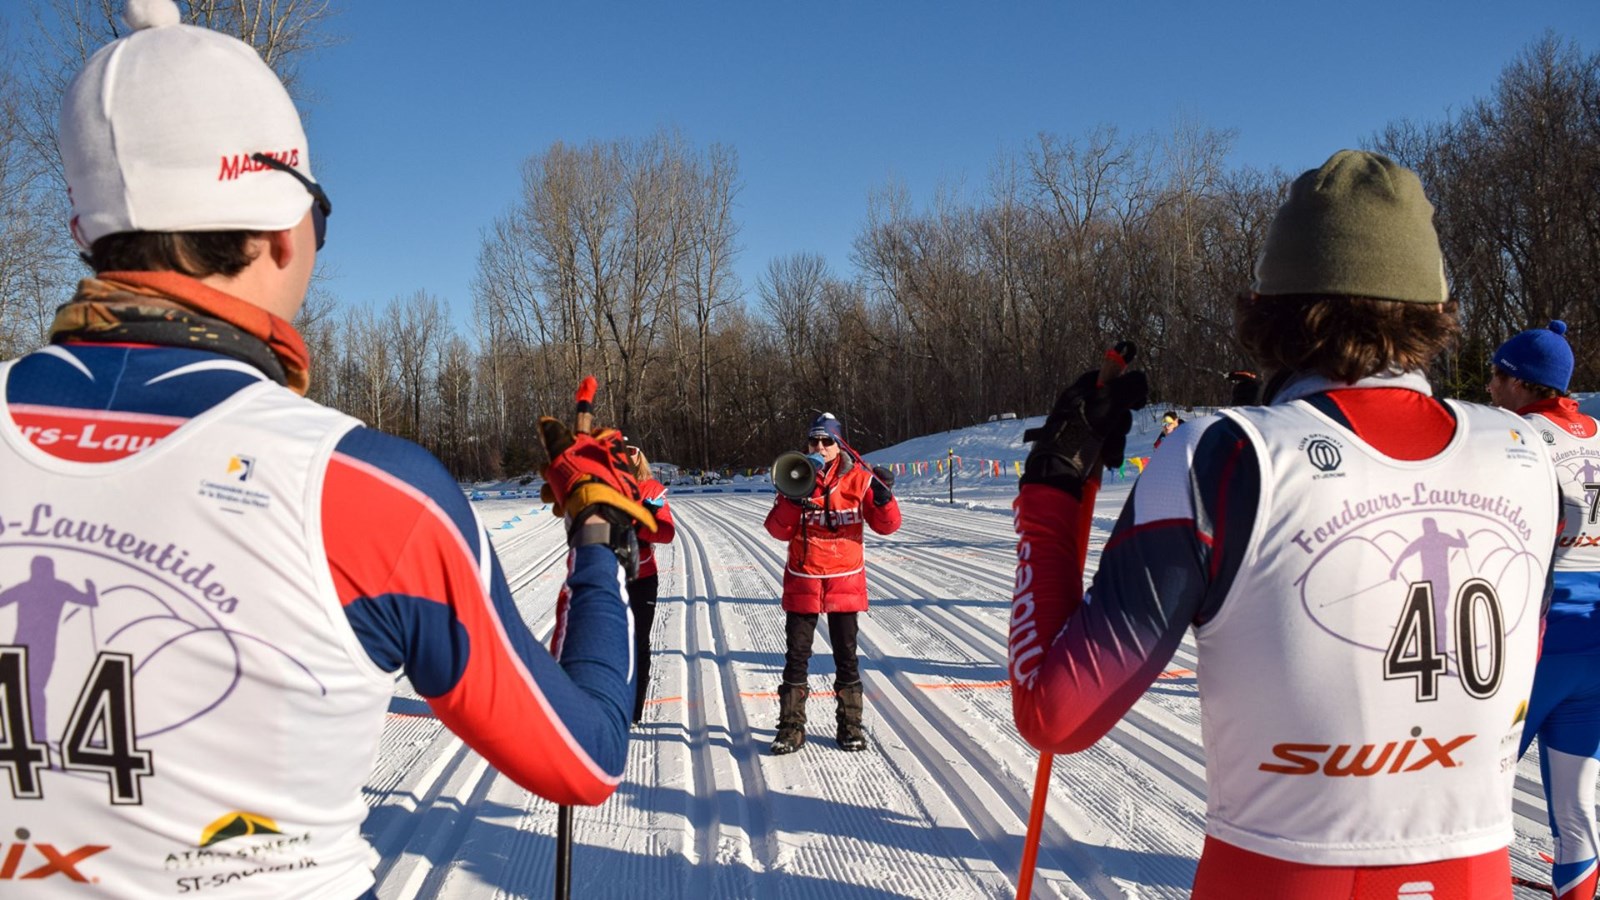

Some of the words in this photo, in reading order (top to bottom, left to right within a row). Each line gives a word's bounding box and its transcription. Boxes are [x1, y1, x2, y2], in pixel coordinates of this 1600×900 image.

[1291, 482, 1533, 555] Fondeurs-Laurentides
[1383, 577, 1505, 702] 40
[0, 827, 112, 884] ix
